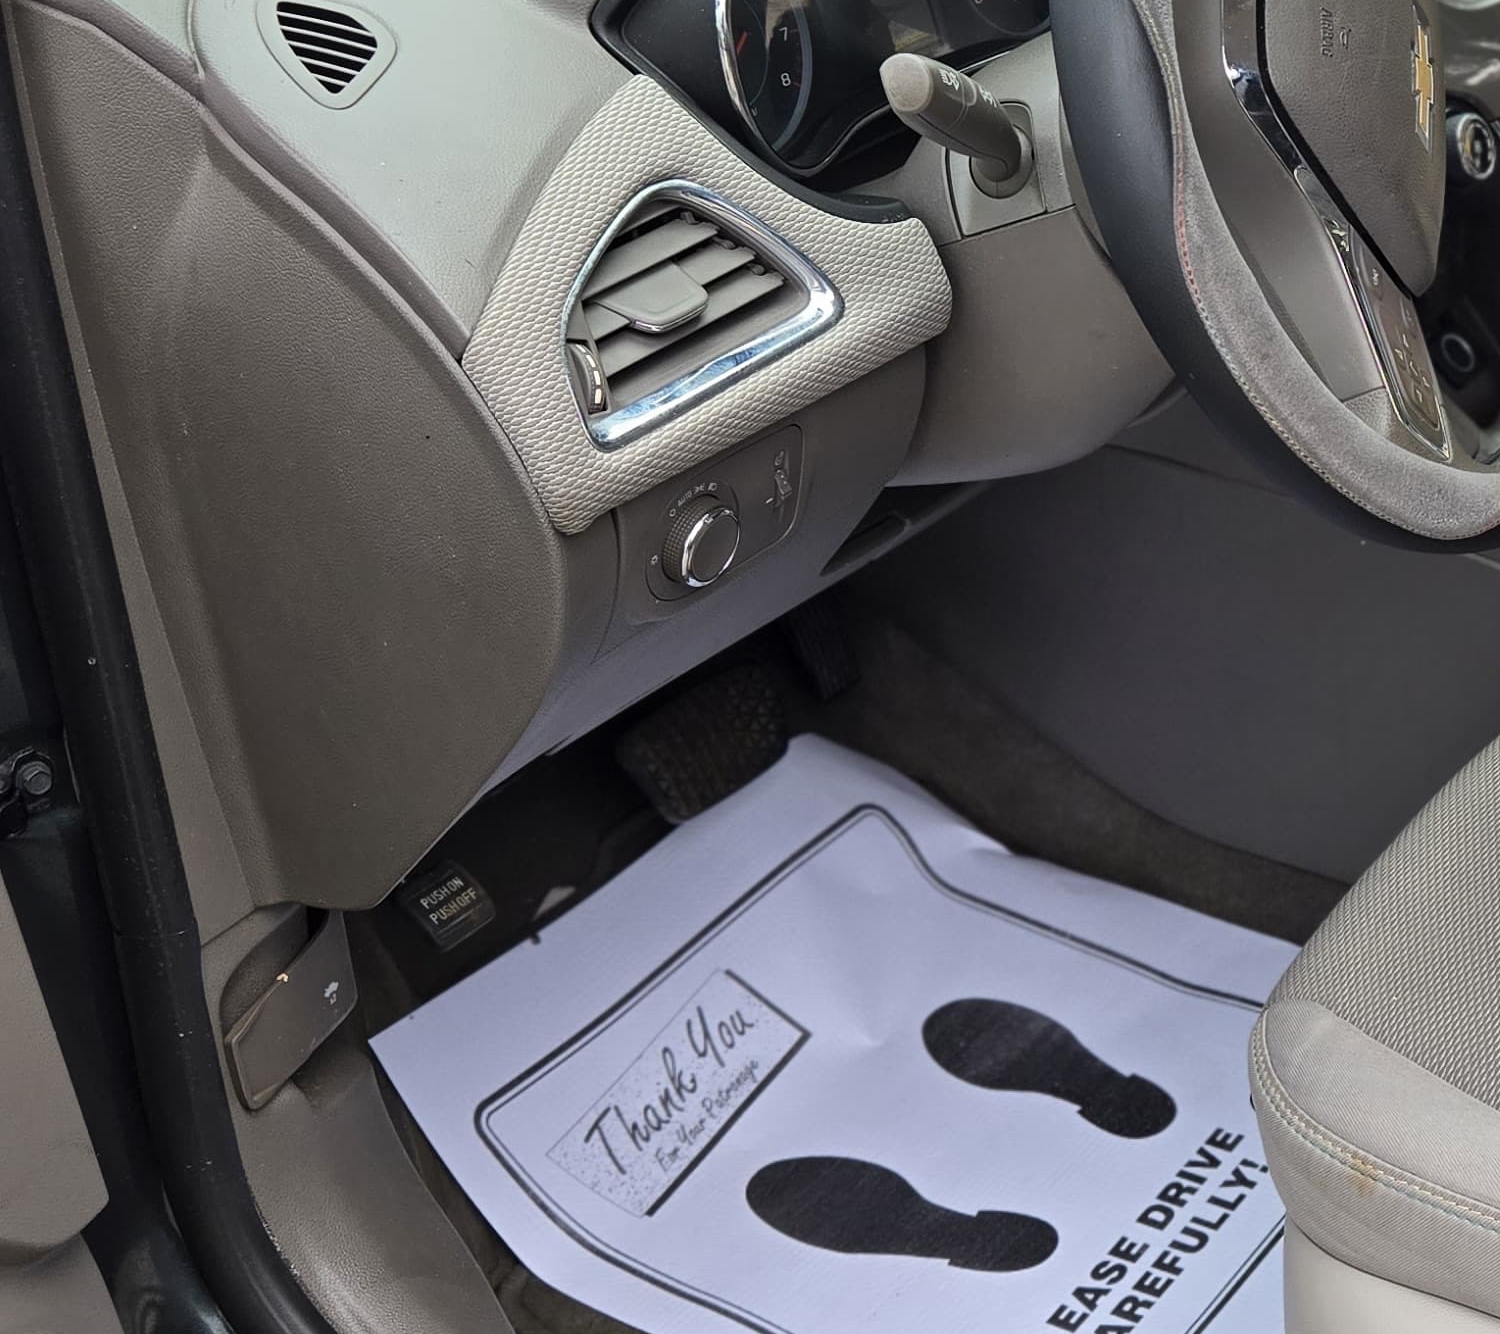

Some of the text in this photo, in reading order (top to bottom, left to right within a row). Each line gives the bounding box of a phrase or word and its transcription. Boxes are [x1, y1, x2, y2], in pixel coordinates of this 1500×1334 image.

[779, 27, 789, 42] 7
[780, 73, 791, 87] 8
[420, 876, 465, 909] PUSH ON
[428, 887, 477, 925] PUSH OFF
[584, 1005, 755, 1175] Thank You
[654, 1059, 760, 1172] For Your Patronage
[1135, 1127, 1245, 1231] DRIVE
